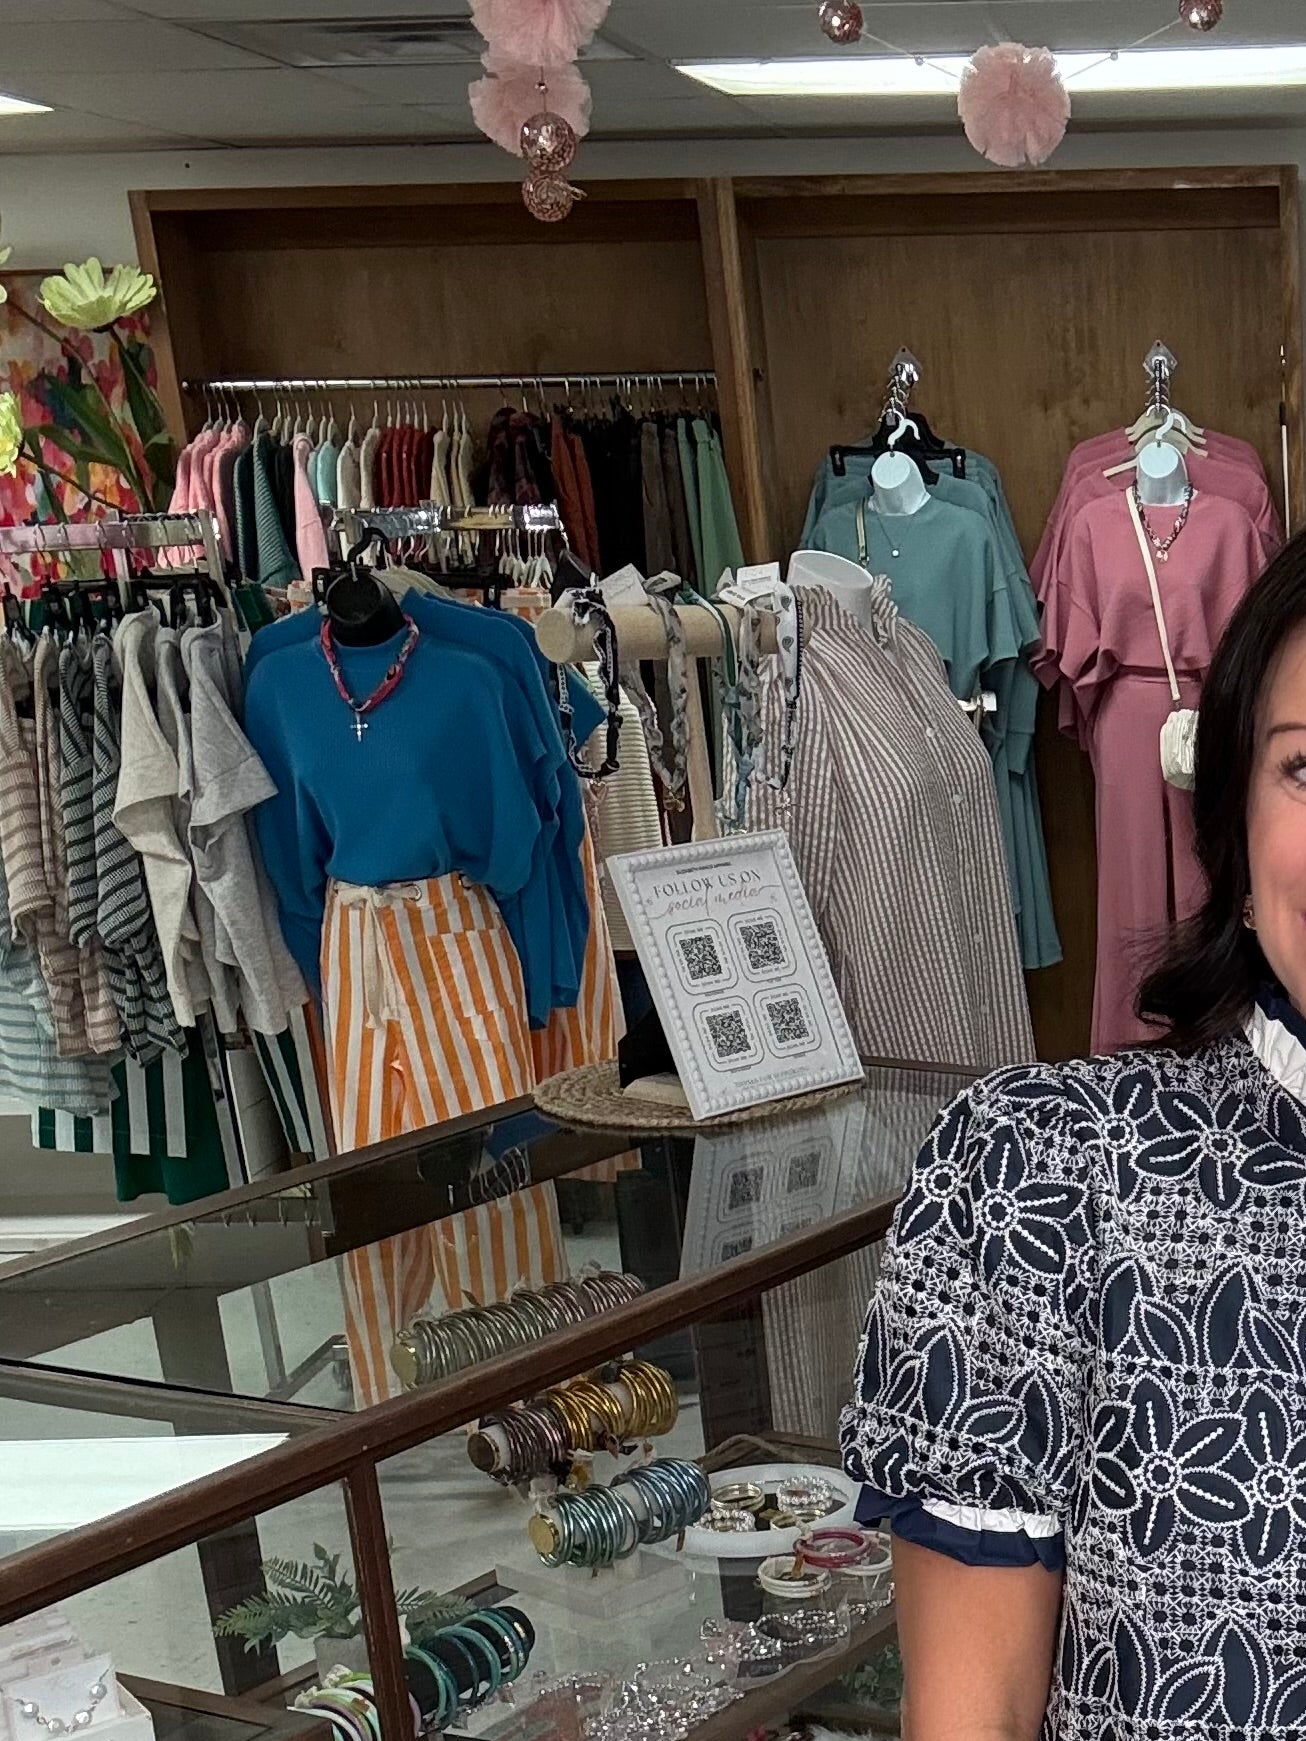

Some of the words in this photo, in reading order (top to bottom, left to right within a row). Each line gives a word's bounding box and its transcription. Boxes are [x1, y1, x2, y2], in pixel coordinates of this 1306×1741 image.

[653, 877, 714, 899] FOLLOW
[718, 873, 737, 887] US
[741, 869, 762, 884] ON
